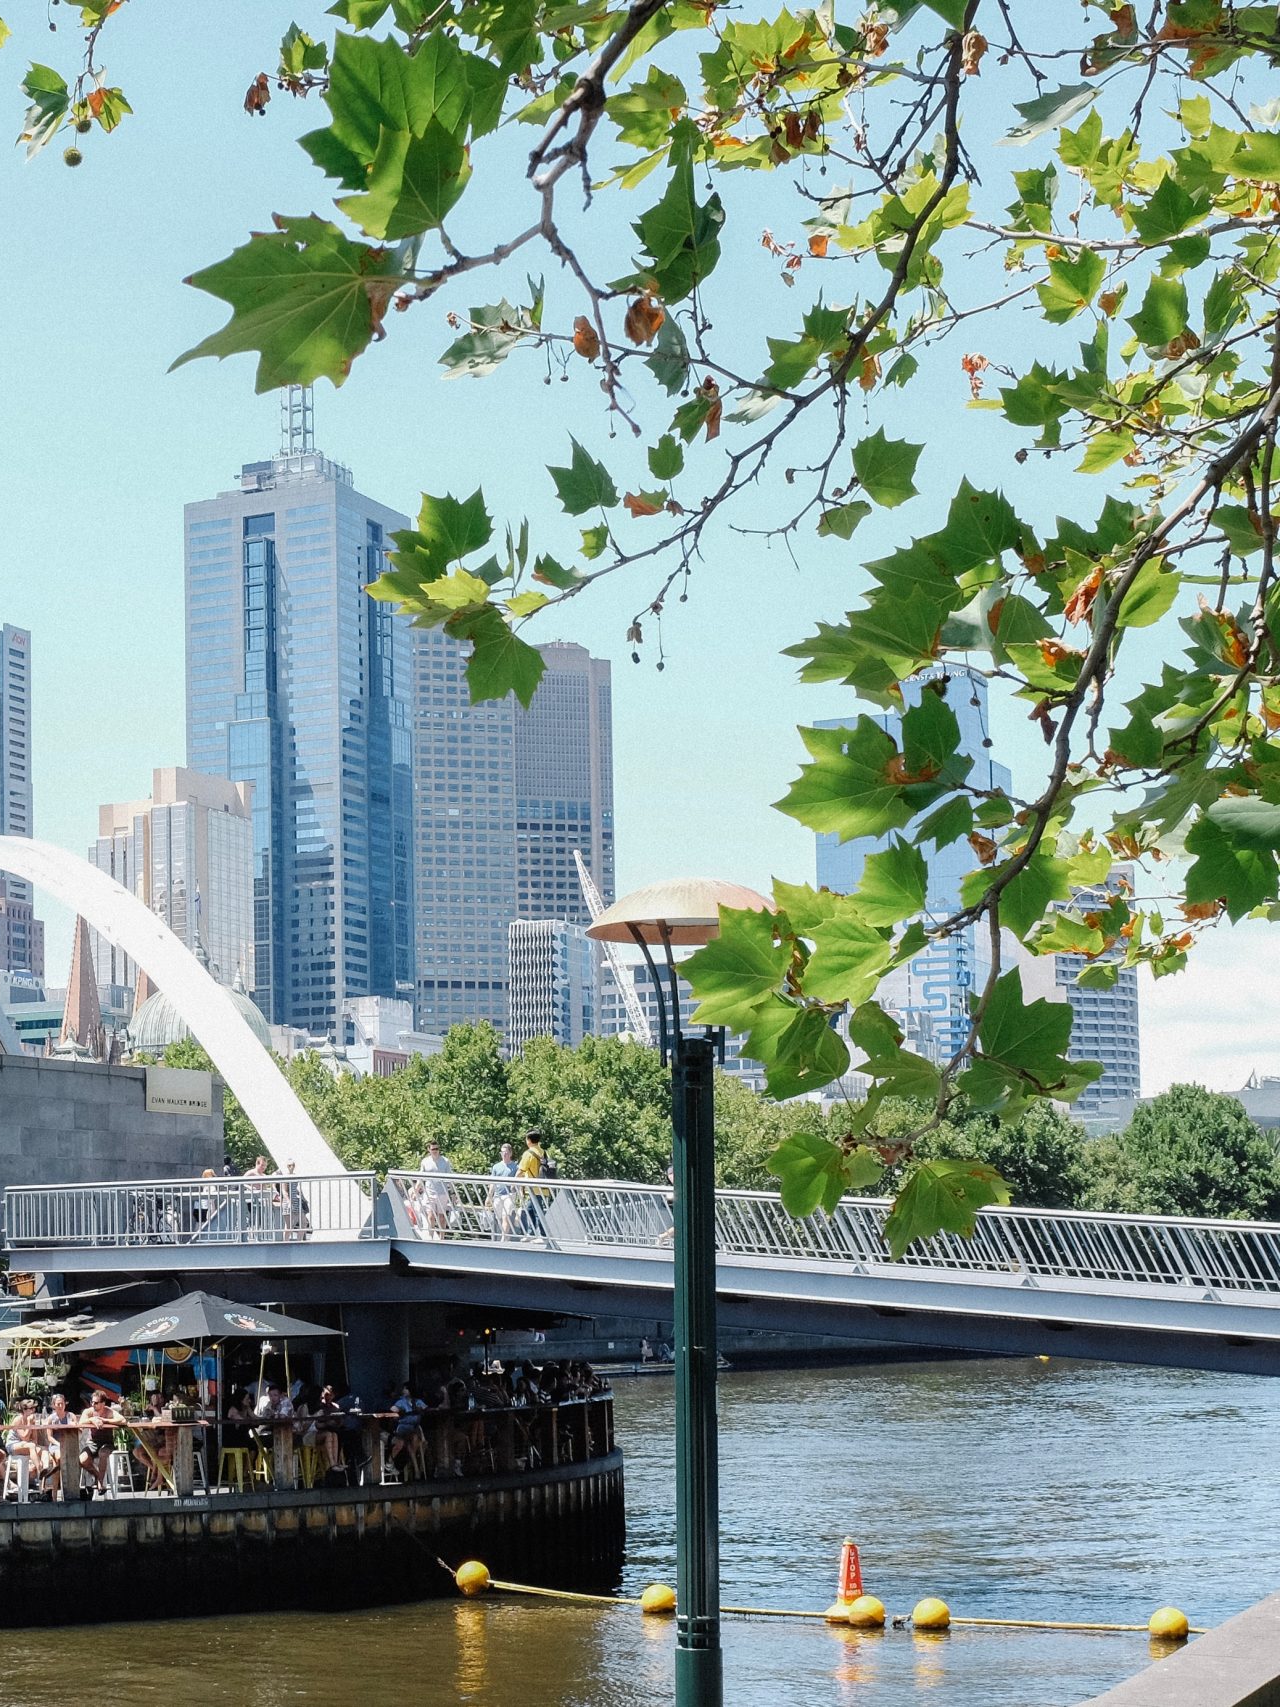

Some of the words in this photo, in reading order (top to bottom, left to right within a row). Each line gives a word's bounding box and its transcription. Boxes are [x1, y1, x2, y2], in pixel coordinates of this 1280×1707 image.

[151, 1096, 165, 1104] EVAN
[166, 1098, 187, 1106] WALKER
[188, 1099, 208, 1108] BRIDGE
[849, 1548, 857, 1580] STOP
